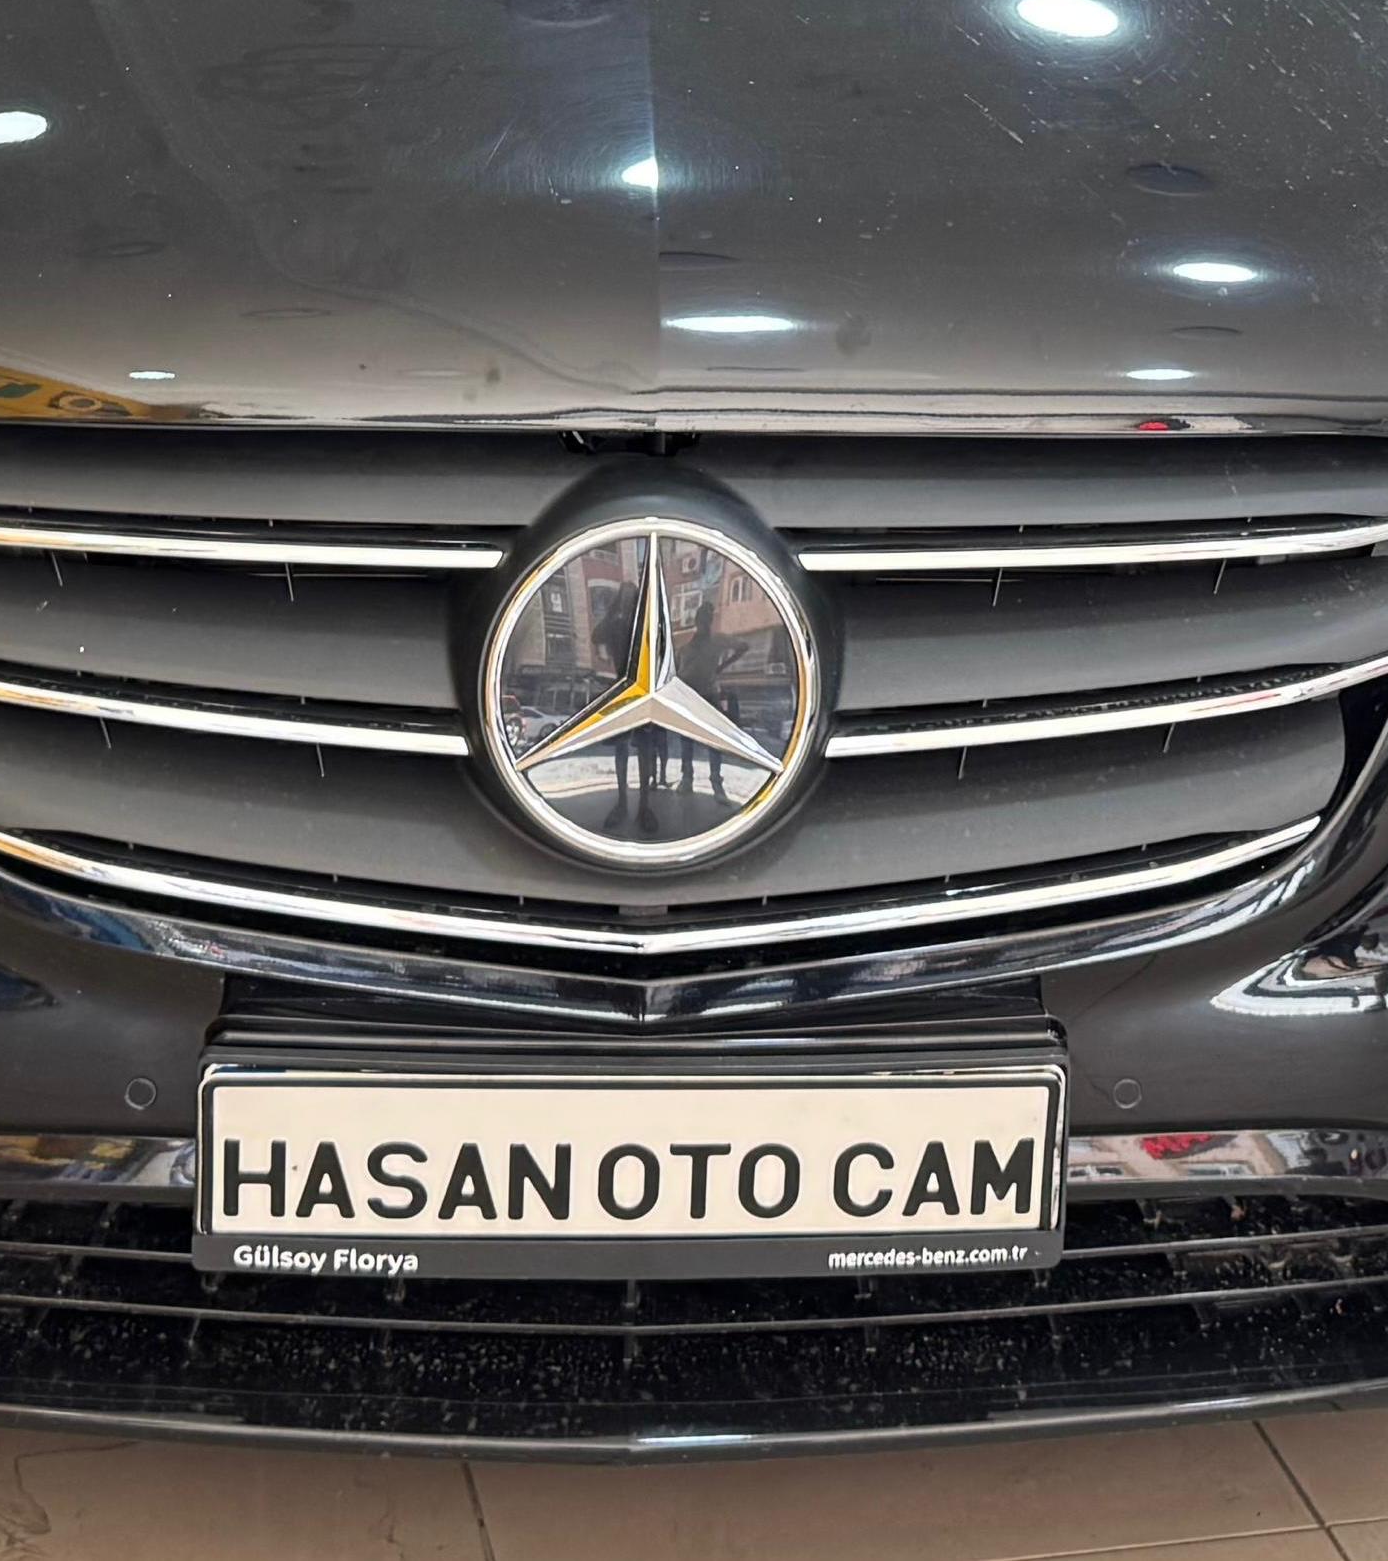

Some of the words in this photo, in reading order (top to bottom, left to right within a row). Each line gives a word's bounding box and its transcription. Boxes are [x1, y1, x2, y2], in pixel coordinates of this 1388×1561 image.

[223, 1137, 572, 1221] HASAN
[597, 1141, 801, 1220] OTO
[832, 1136, 1035, 1218] CAM
[233, 1244, 328, 1275] Gülsoy
[333, 1246, 419, 1277] Florya
[828, 1245, 1028, 1268] mercedes-benz.com.tr
